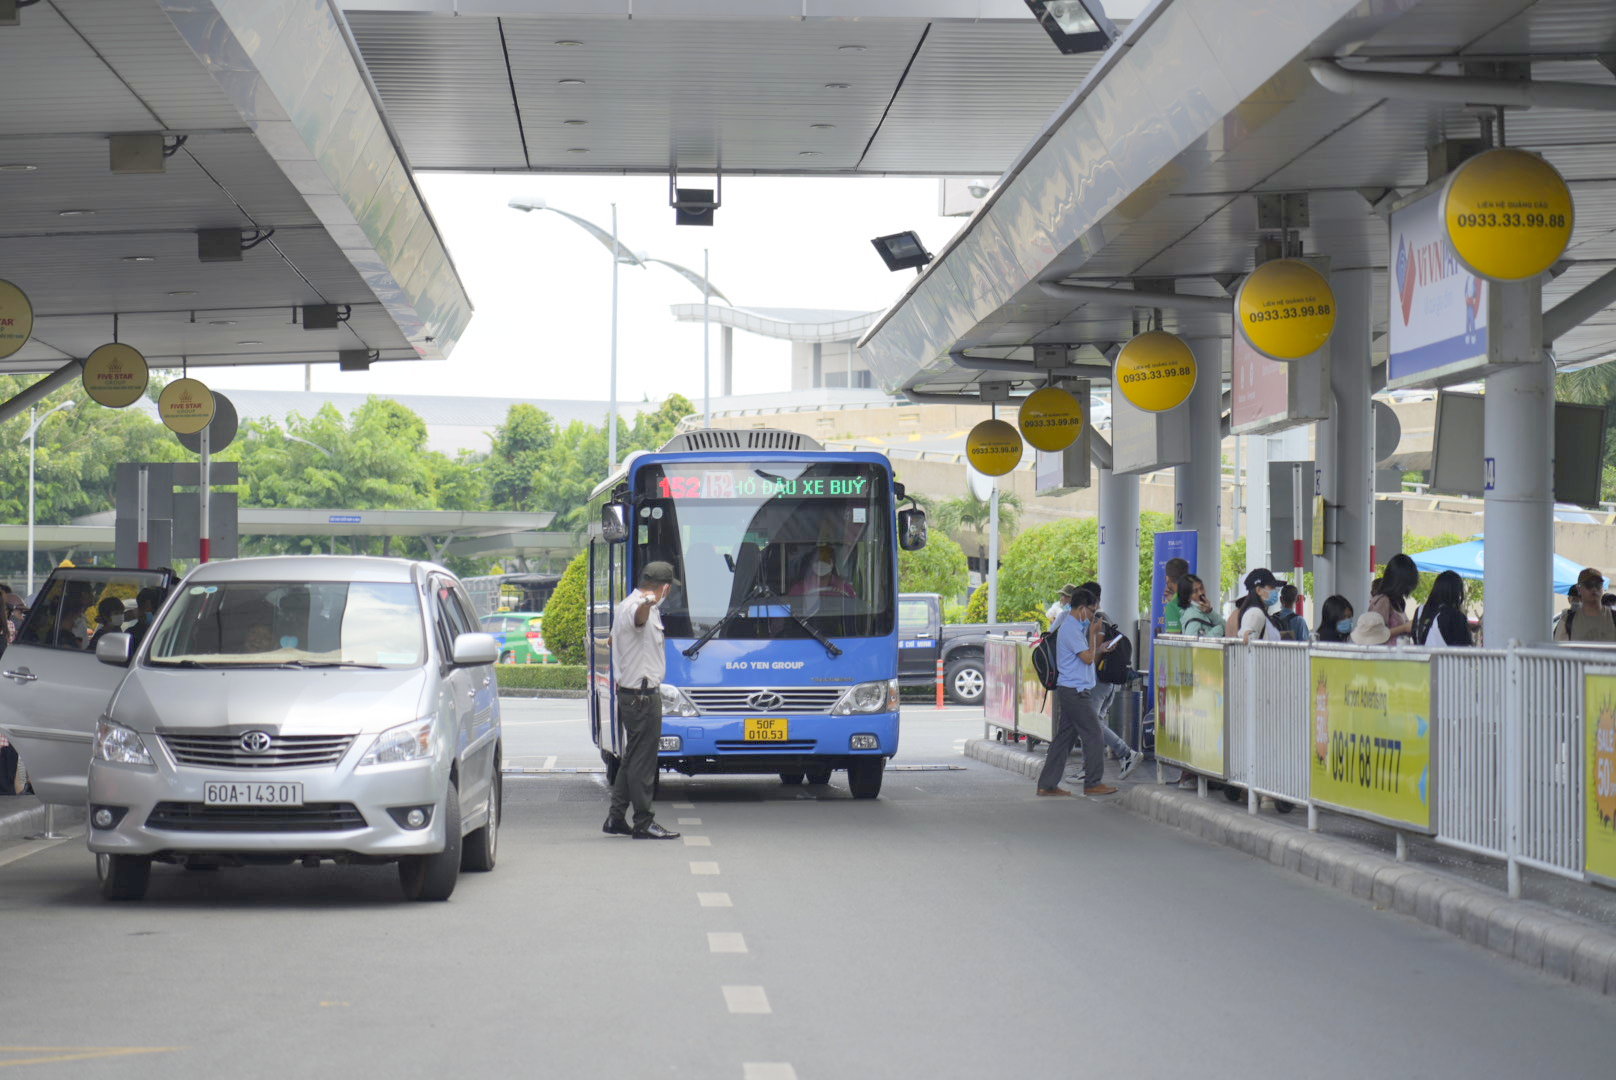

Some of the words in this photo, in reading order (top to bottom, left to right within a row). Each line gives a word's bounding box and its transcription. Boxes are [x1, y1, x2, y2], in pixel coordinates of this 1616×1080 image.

[1457, 213, 1565, 227] 0933.33.99.88
[1249, 304, 1331, 323] 0933.33.99.88
[1123, 366, 1191, 383] 0933.33.99.88
[1024, 417, 1079, 427] 0933.33.99.88
[659, 476, 700, 498] 152
[762, 477, 797, 498] ĐẬU
[803, 480, 824, 495] XE
[830, 476, 867, 495] BUÝ
[725, 661, 748, 670] BAO
[750, 661, 769, 670] YEN
[771, 661, 805, 670] GROUP
[756, 720, 775, 729] 50F
[748, 730, 783, 740] 010.53
[1597, 728, 1614, 753] SALE
[1332, 730, 1356, 783] 0917
[1359, 734, 1371, 788] 68
[1374, 737, 1402, 793] 7777
[208, 784, 297, 803] 60A-143.01
